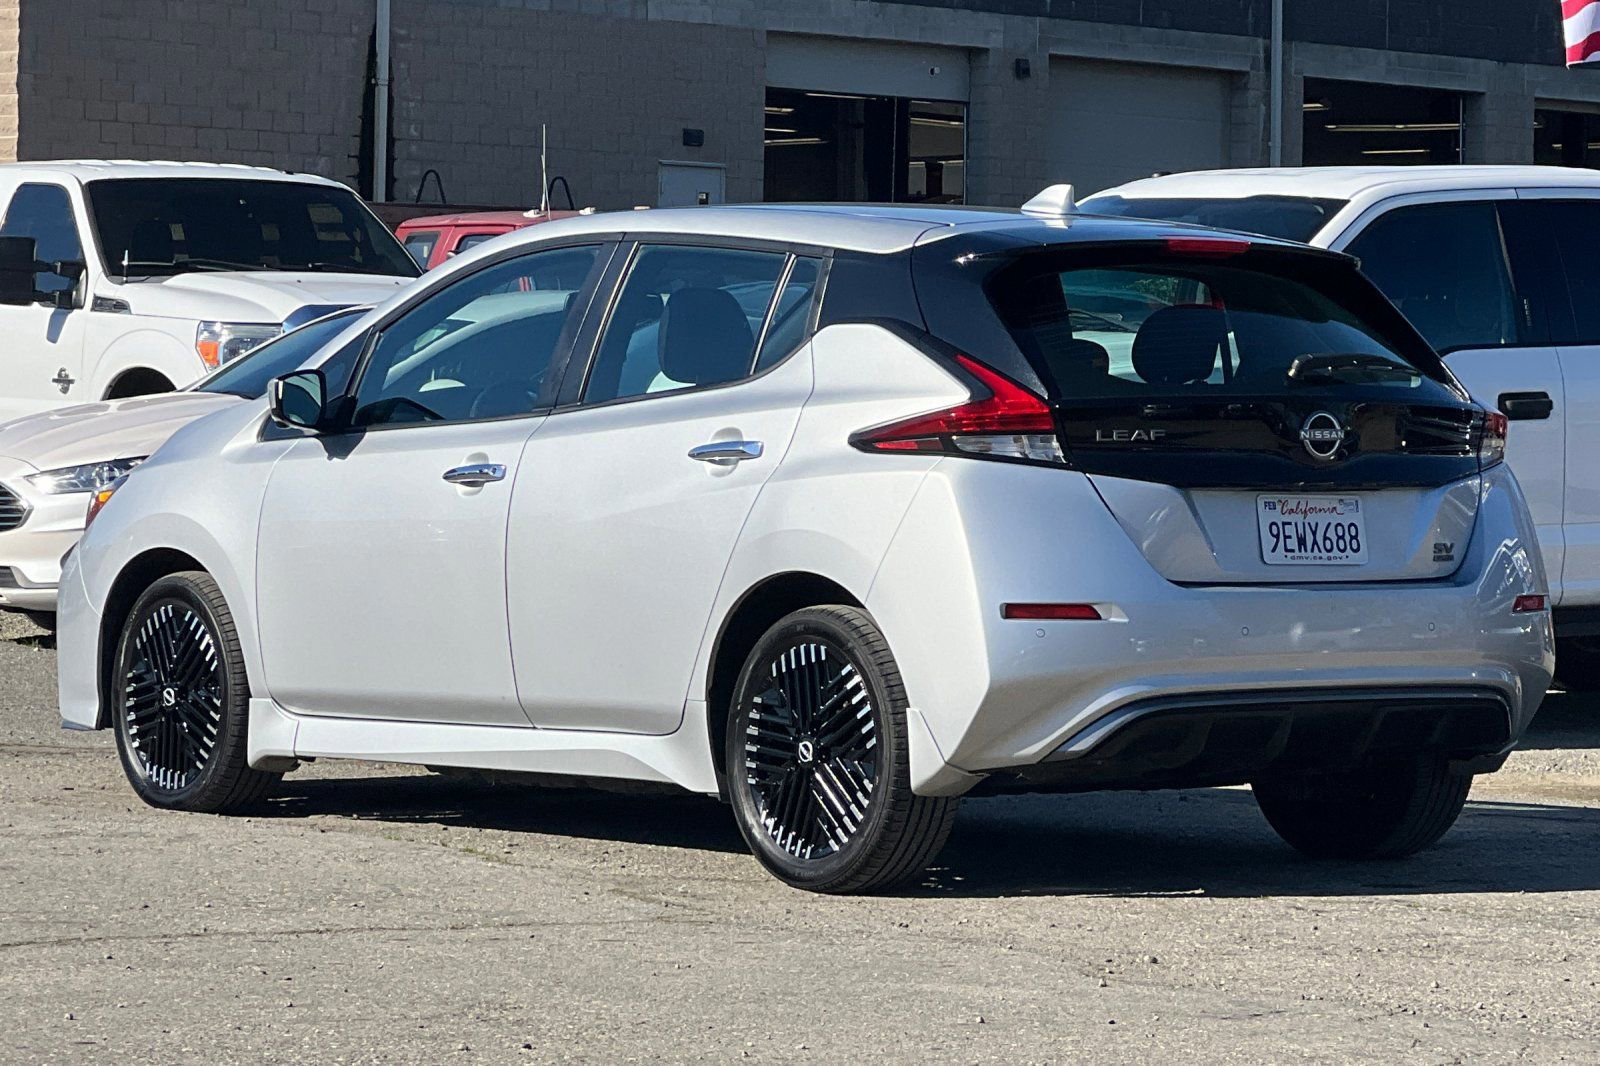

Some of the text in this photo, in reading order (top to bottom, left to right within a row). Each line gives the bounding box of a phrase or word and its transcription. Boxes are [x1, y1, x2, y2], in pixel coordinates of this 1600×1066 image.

[1096, 430, 1166, 441] LEAF
[1300, 430, 1345, 439] NISSAN
[1280, 499, 1344, 520] California
[1269, 521, 1361, 553] 9EWX688
[1433, 543, 1455, 554] SV
